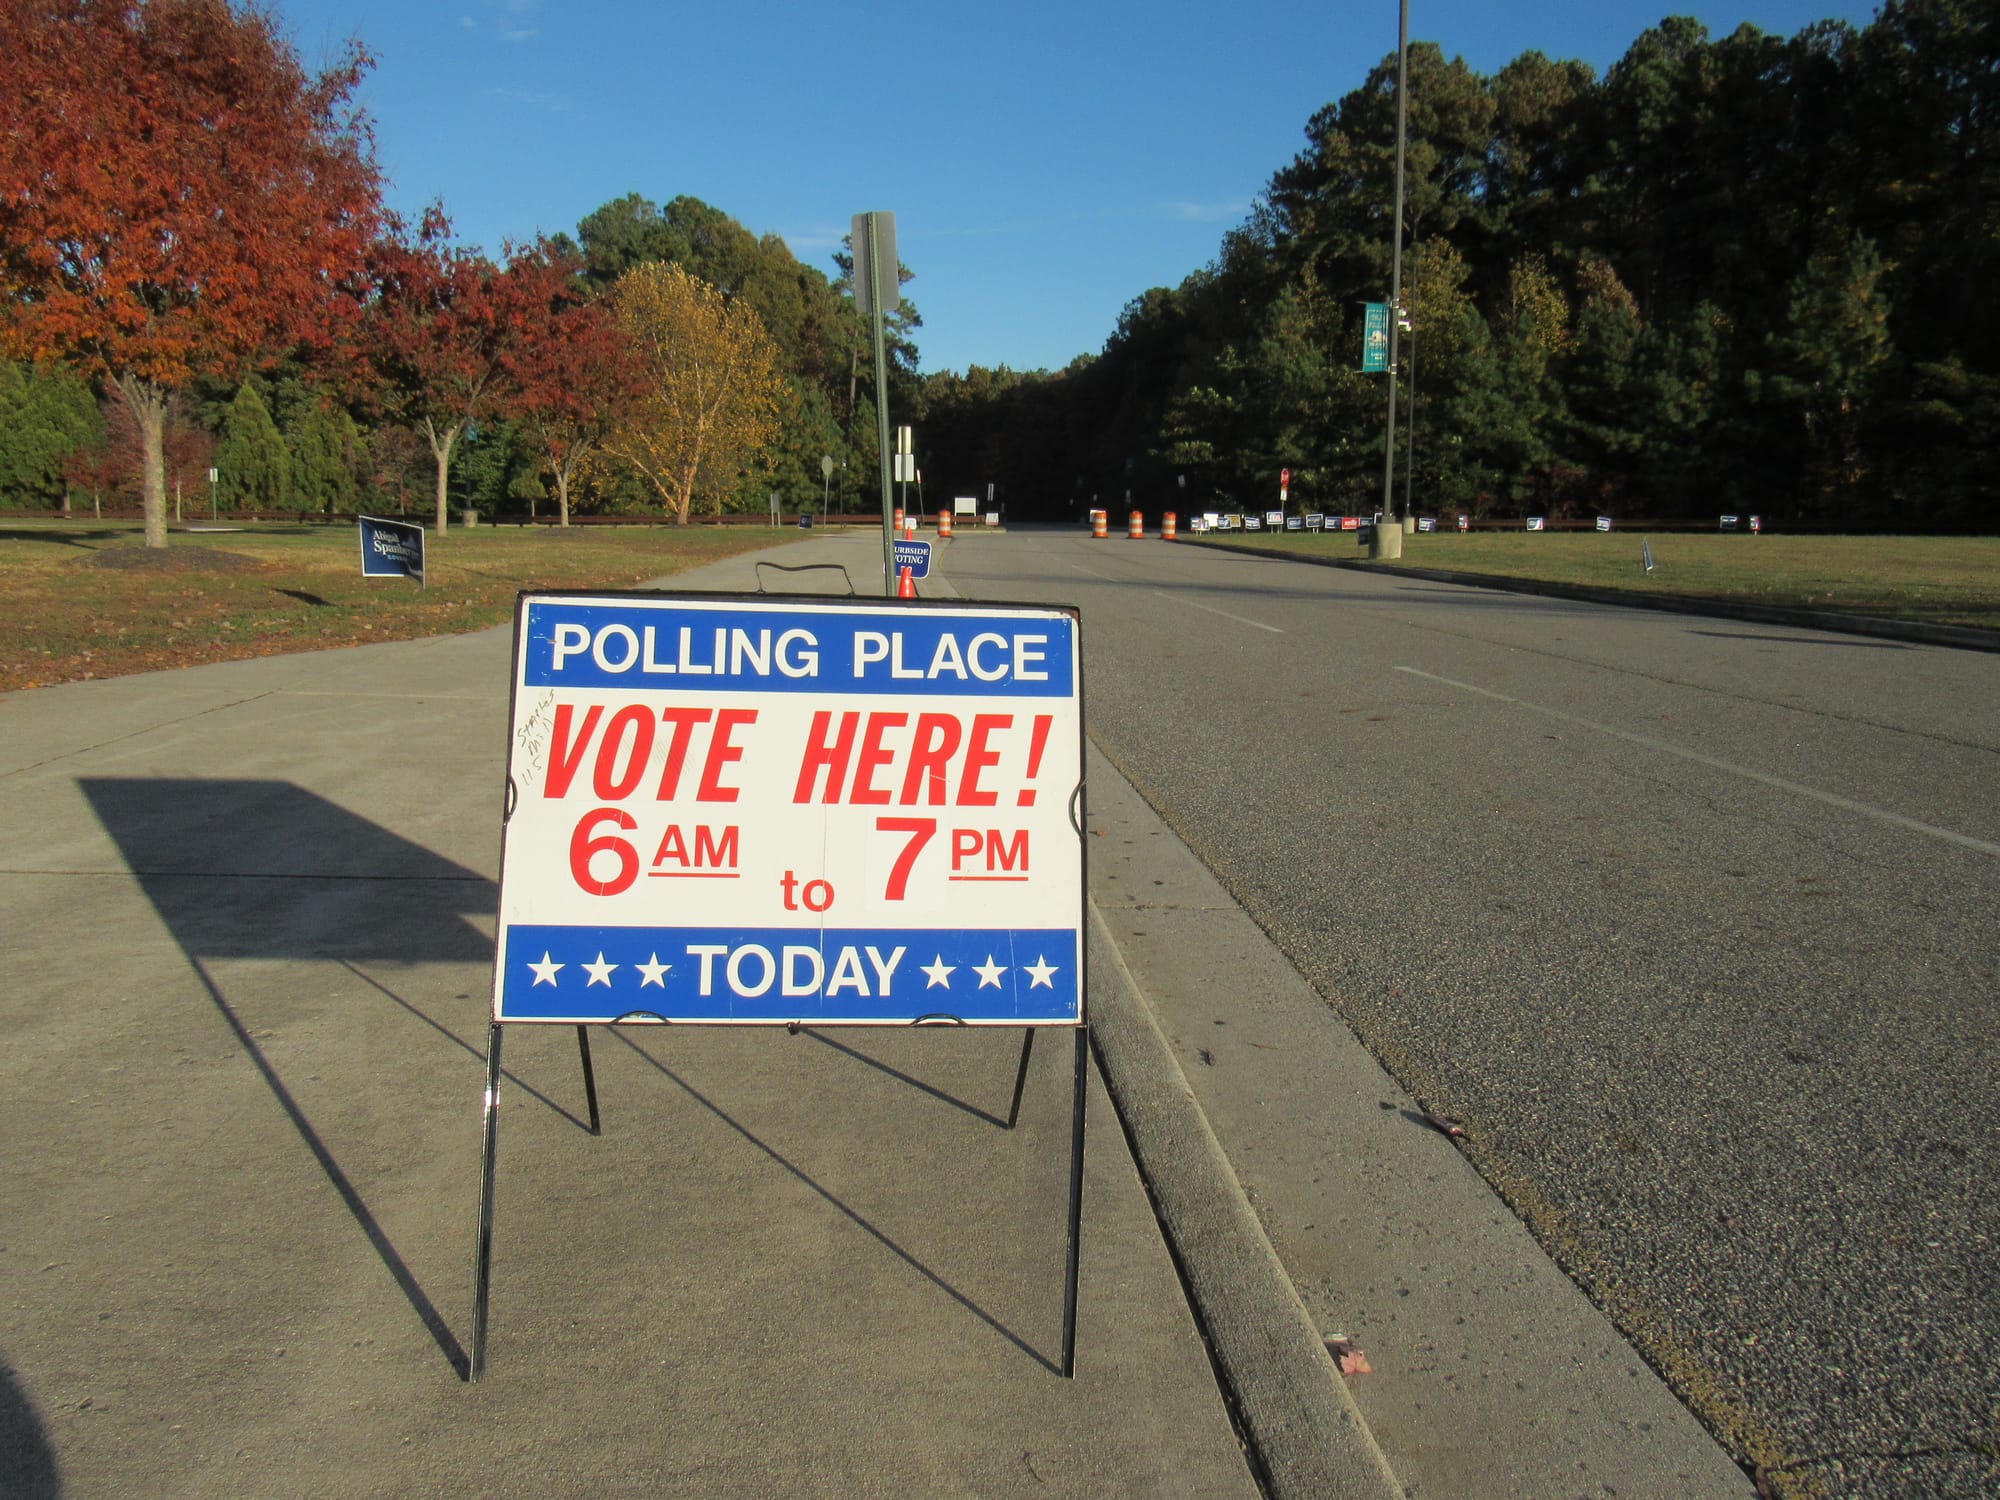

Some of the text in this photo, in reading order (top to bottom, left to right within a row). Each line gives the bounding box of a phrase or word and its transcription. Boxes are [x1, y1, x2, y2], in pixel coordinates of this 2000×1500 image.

[894, 546, 928, 556] URBSIDE
[895, 554, 923, 564] OTING
[551, 622, 1049, 682] POLLING PLACE
[543, 703, 1054, 808] VOTE HERE!
[569, 806, 1030, 913] 6 AM to 7 PM
[686, 943, 908, 998] TODAY
